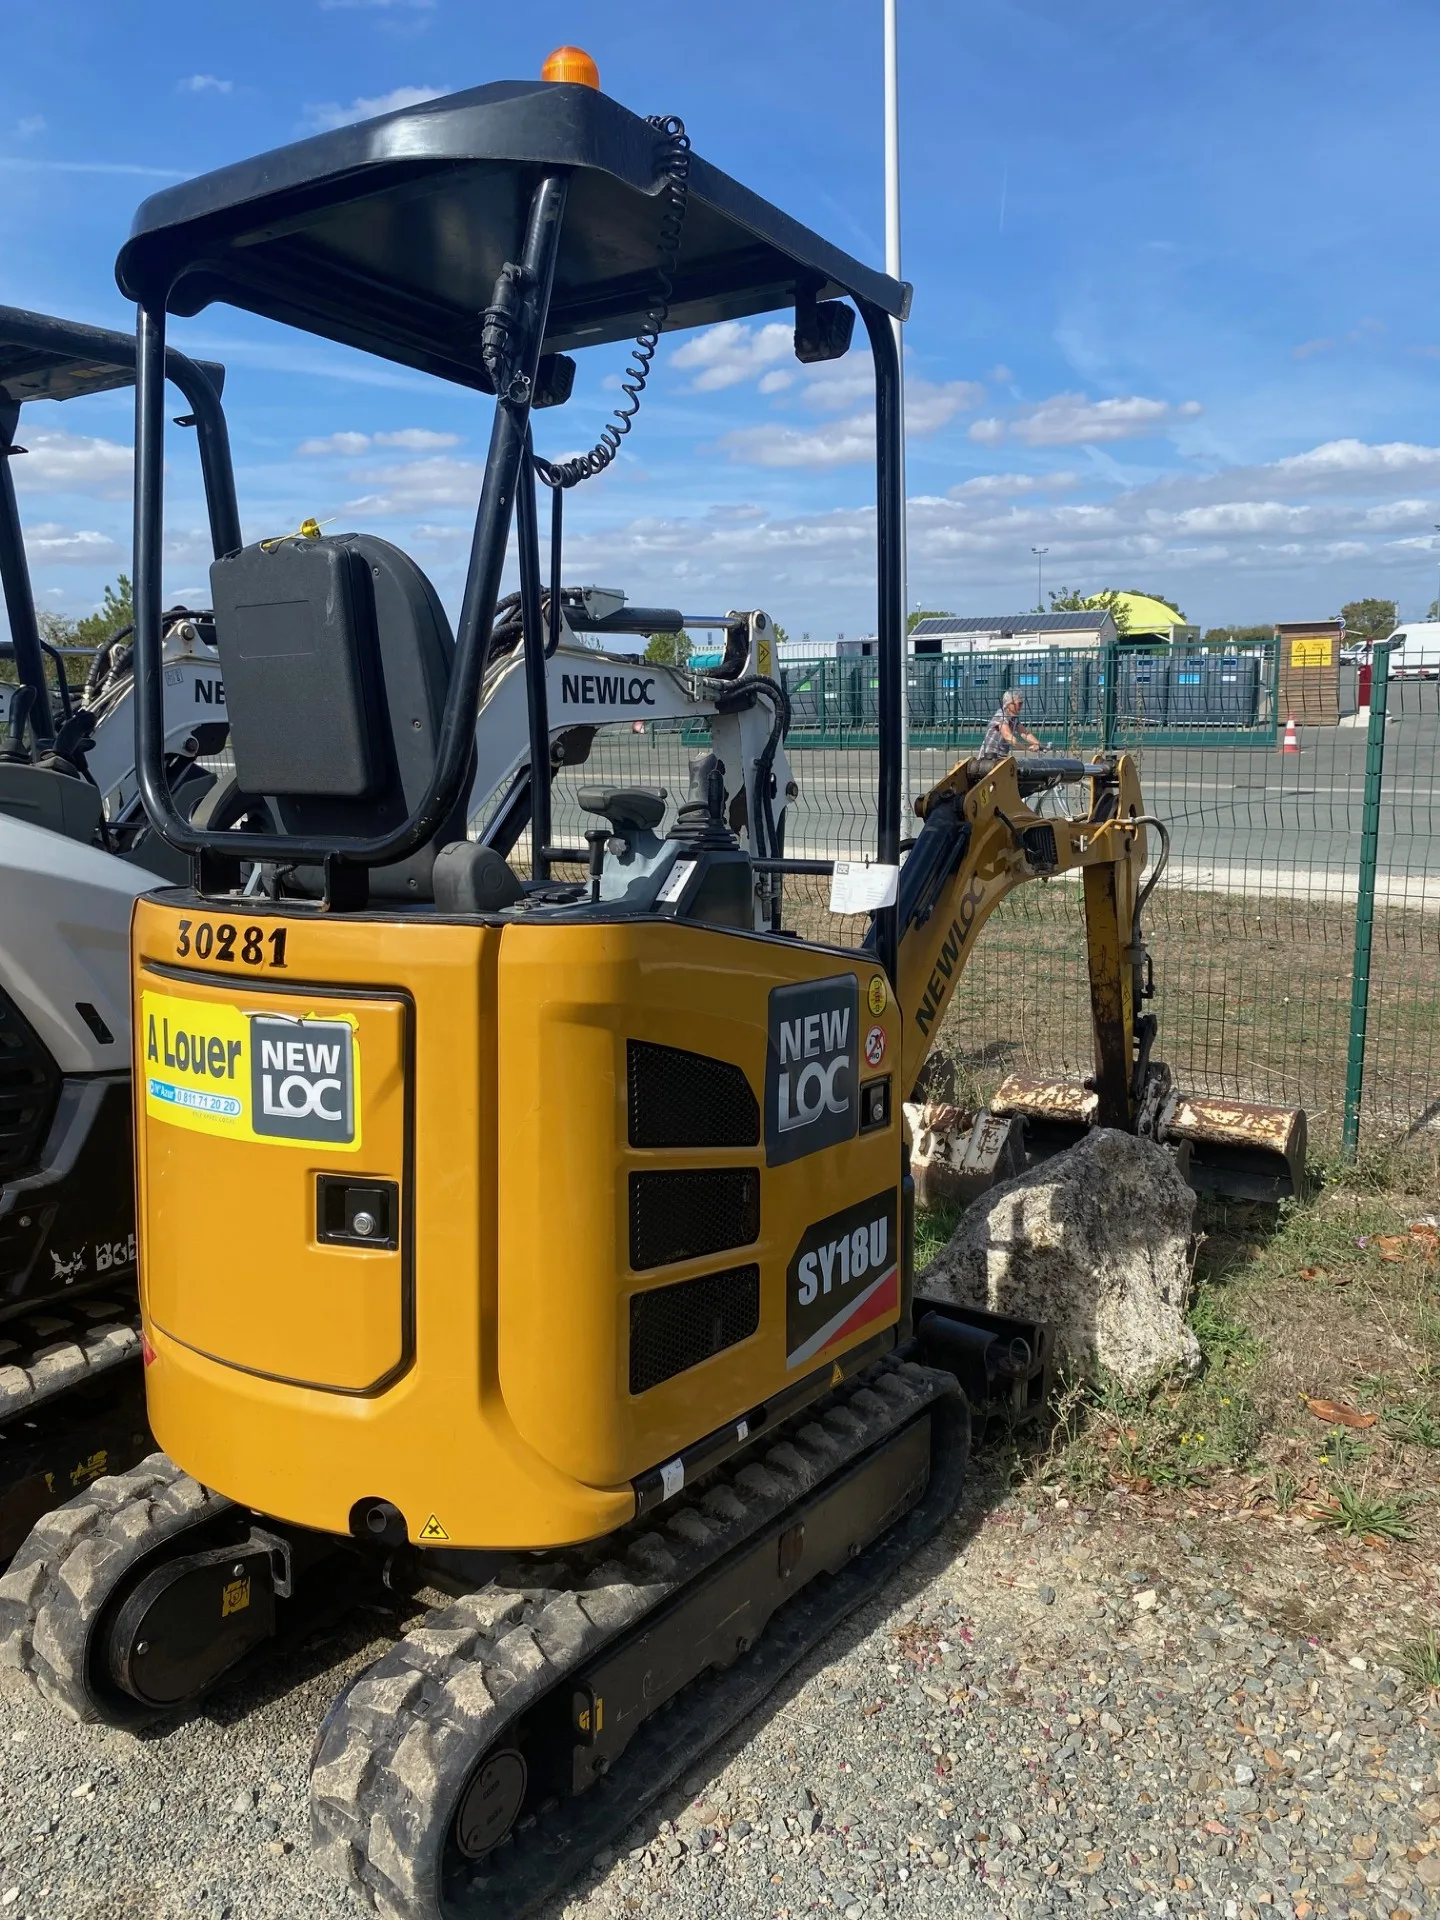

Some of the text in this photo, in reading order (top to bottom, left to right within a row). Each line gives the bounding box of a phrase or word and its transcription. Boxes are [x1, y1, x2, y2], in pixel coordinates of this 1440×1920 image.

[562, 674, 655, 705] NEWLOC
[176, 919, 288, 968] 30281
[915, 873, 986, 1037] NEWLOC
[147, 1014, 242, 1079] A Louer
[261, 1040, 341, 1075] NEW
[779, 1007, 850, 1064] NEW
[177, 1090, 182, 1102] 0
[183, 1092, 196, 1105] 811
[199, 1096, 208, 1107] 71
[210, 1098, 221, 1110] 20
[223, 1100, 236, 1112] 20
[262, 1075, 342, 1121] LOC
[778, 1055, 850, 1133] LOC
[798, 1216, 888, 1306] SY18U
